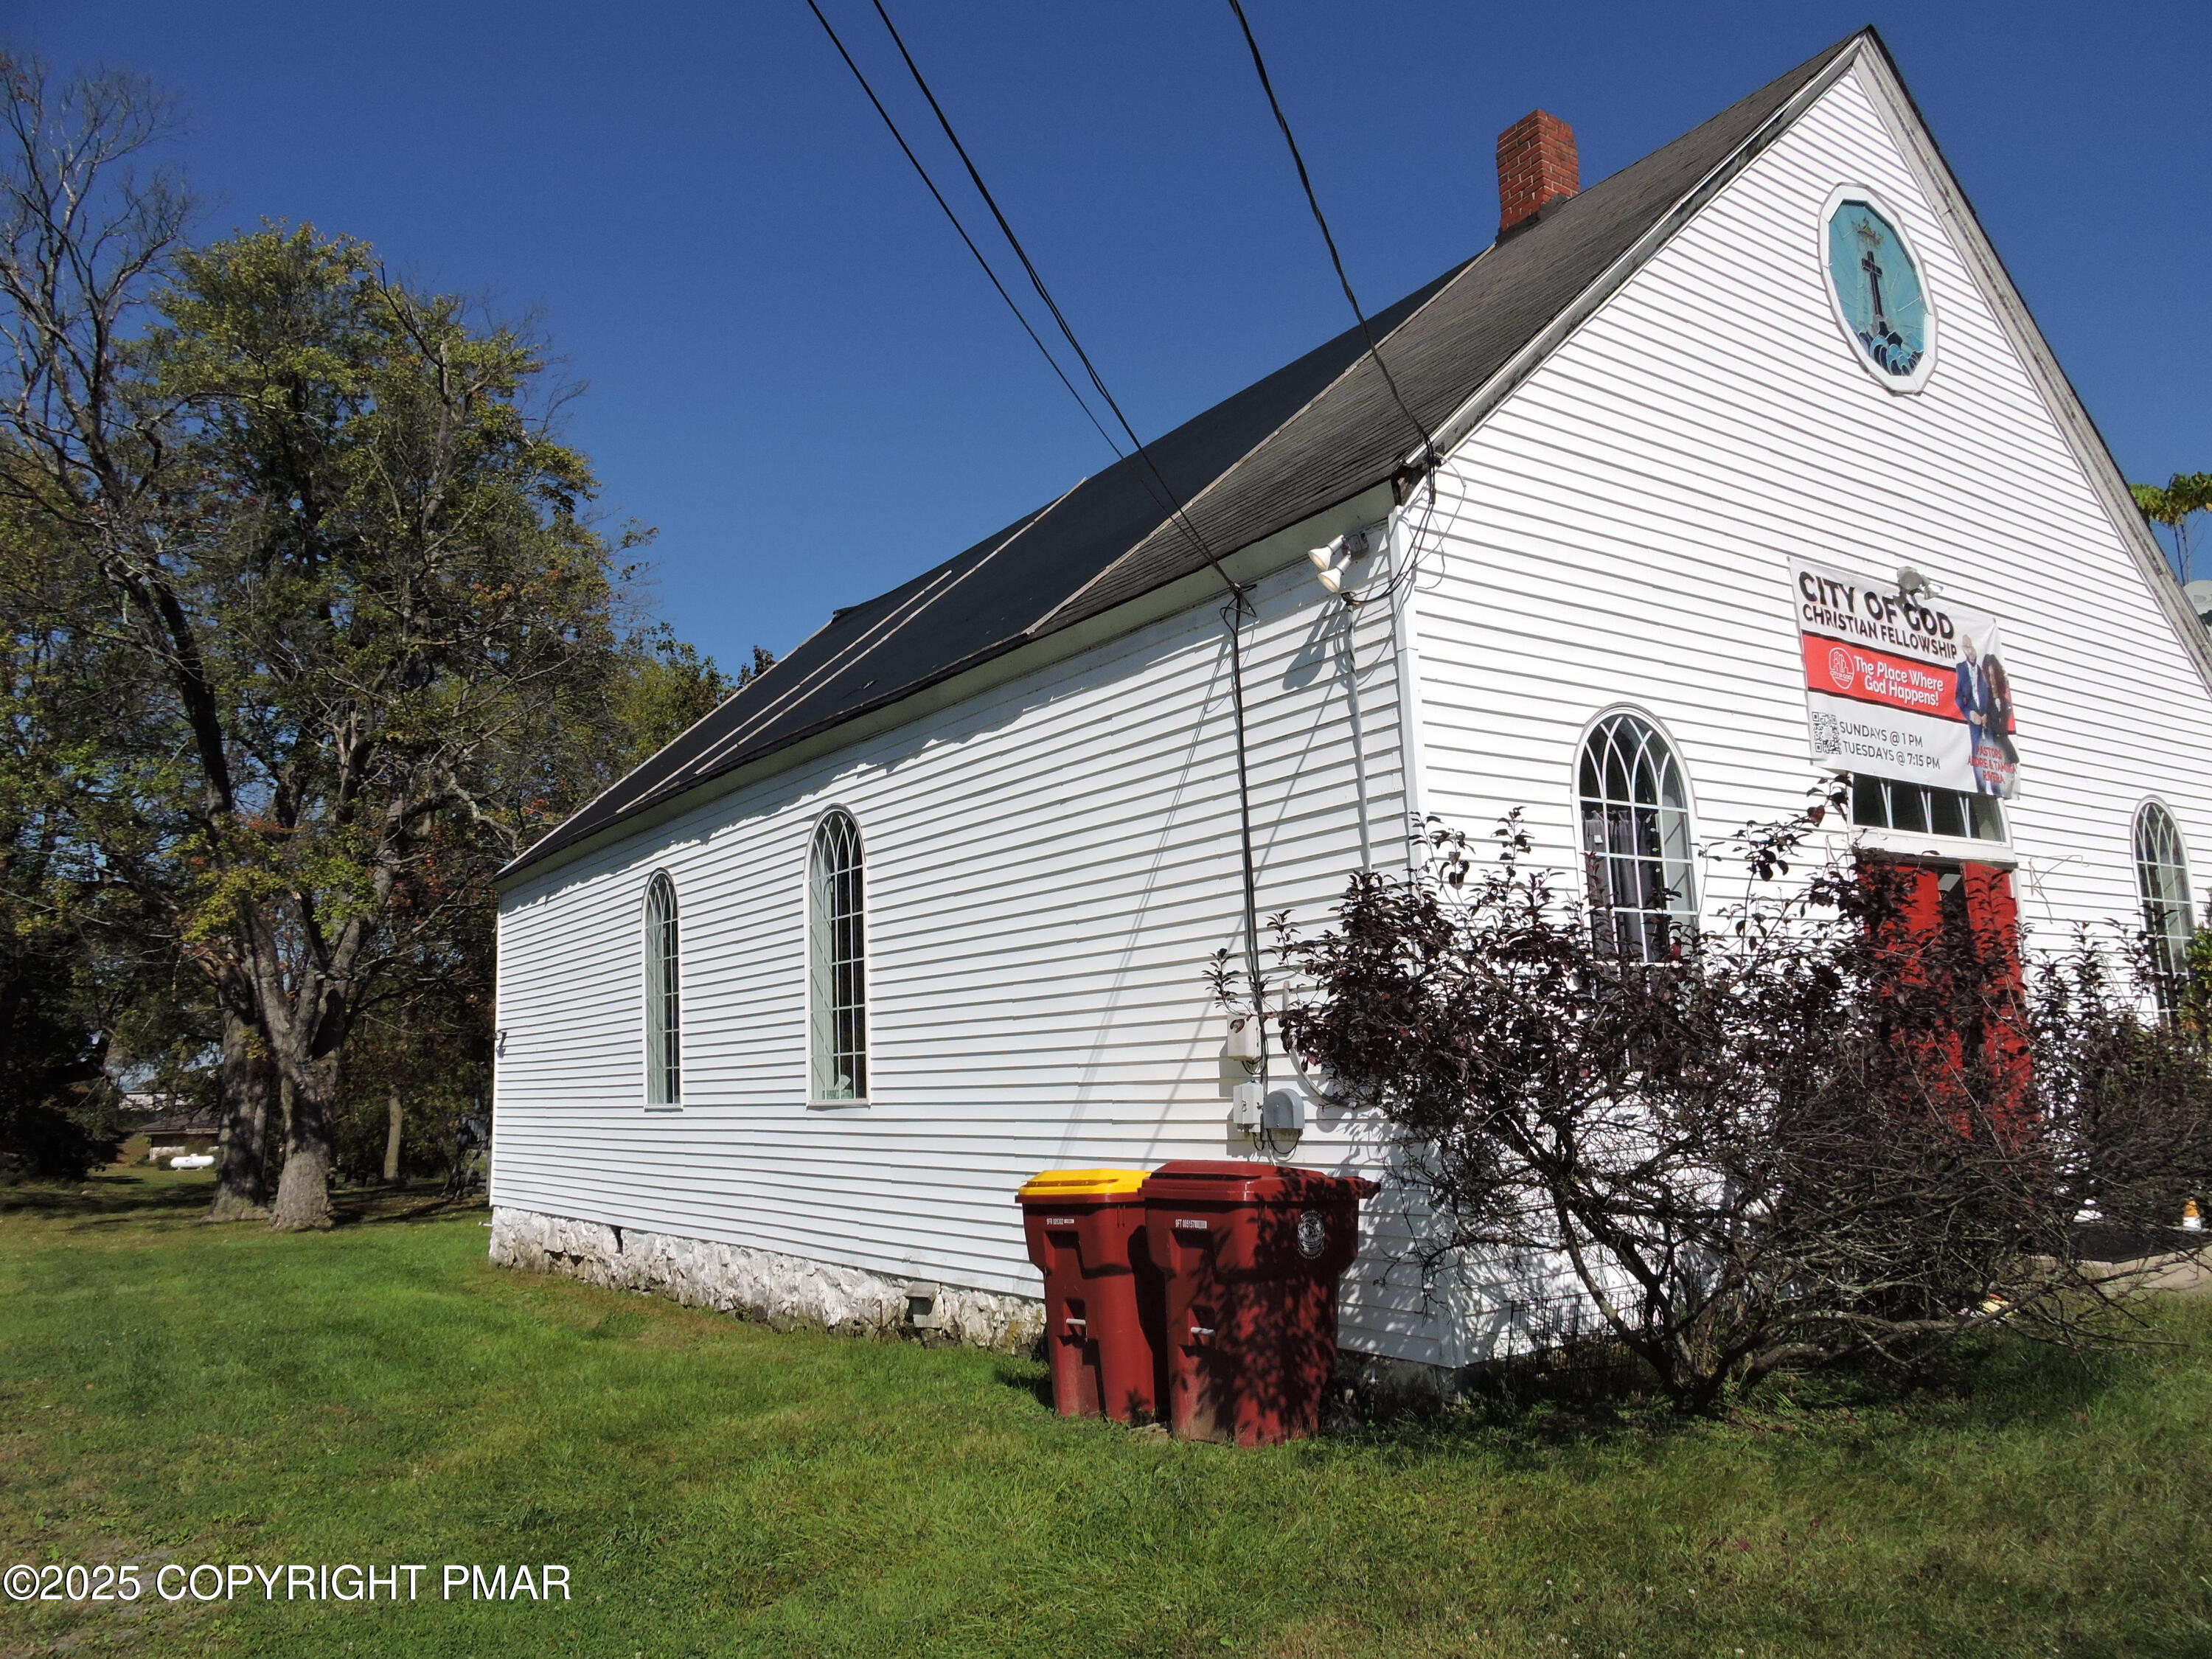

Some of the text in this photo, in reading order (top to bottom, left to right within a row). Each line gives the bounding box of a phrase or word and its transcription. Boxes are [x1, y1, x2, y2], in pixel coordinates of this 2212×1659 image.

[1799, 571, 1954, 639] CITY OF GOD
[1803, 604, 1957, 659] CHRISTIAN FELLOWSHIP
[1854, 655, 1944, 692] The Place Where
[1865, 675, 1939, 706] God Happens!
[1840, 721, 1923, 748] SUNDAYS @ 1 PM
[1843, 740, 1941, 769] TUESDAYS @ 7:15 PM
